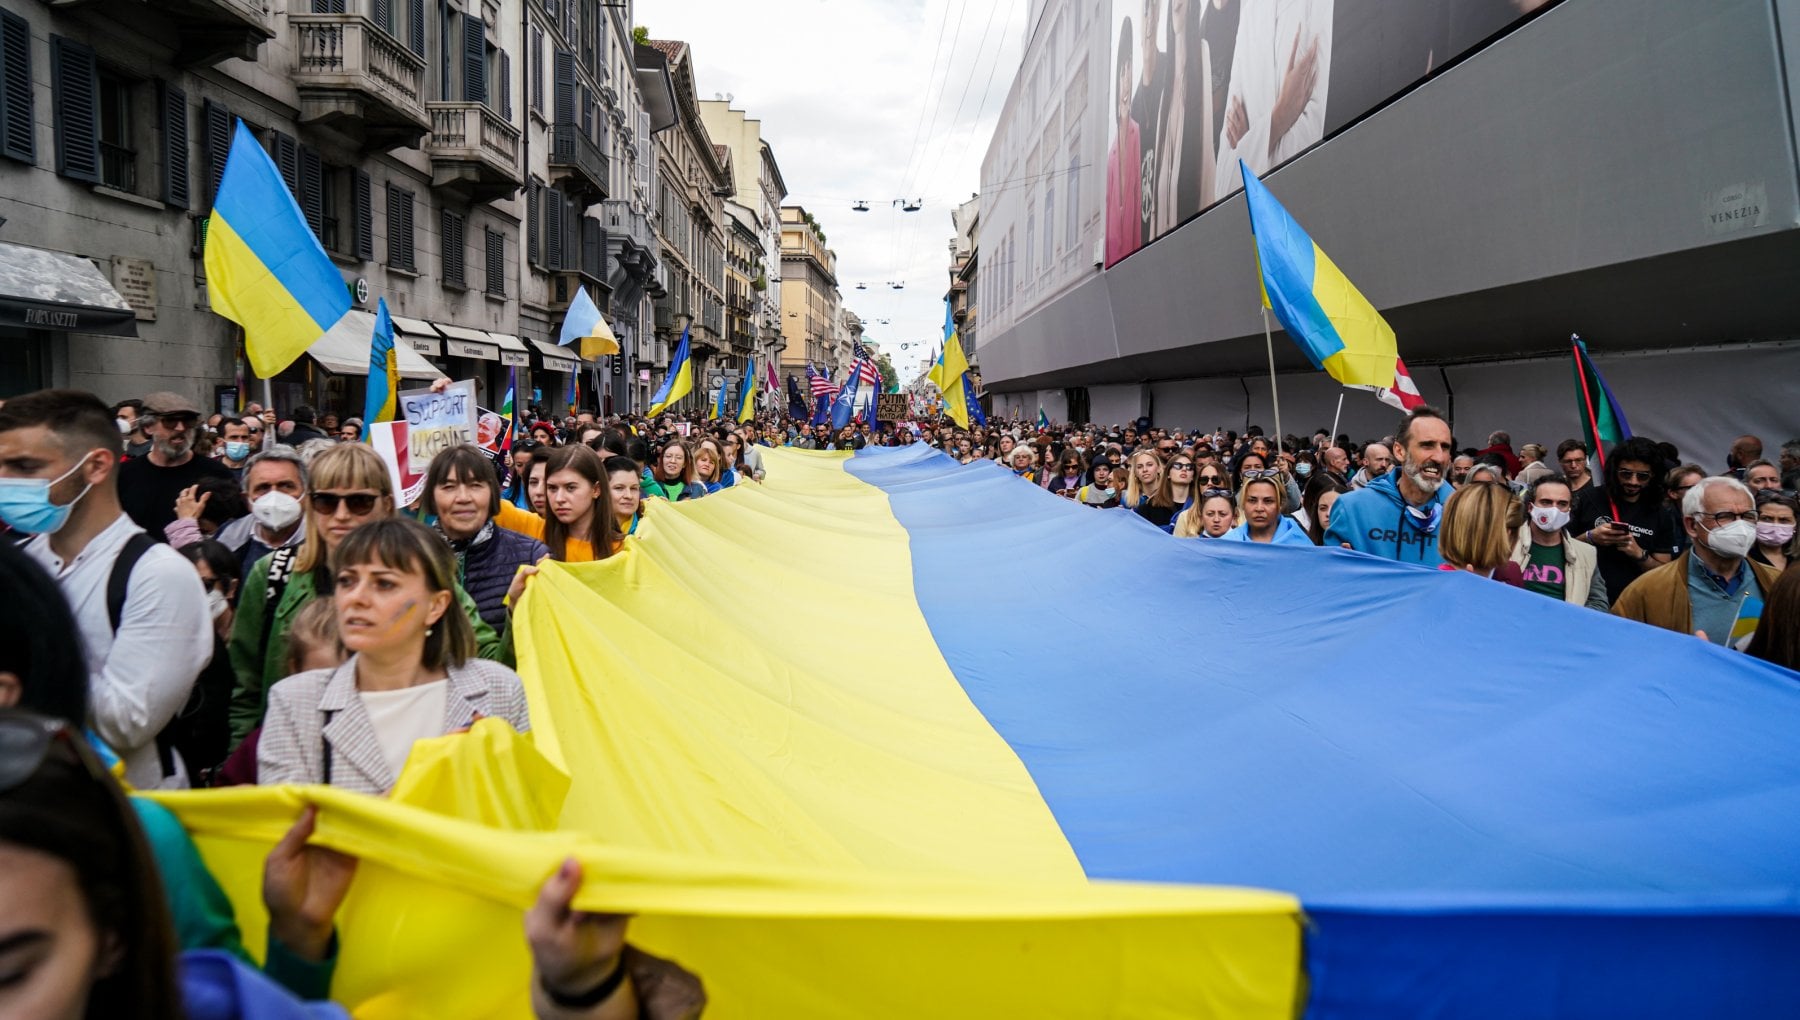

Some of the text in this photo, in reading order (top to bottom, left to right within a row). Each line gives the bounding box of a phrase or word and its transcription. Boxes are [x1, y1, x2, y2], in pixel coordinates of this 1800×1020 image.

[1722, 193, 1743, 203] CORSO
[1710, 205, 1761, 224] VENEZIA
[878, 394, 906, 404] PUTIN
[406, 394, 467, 425] SUPPORT
[1368, 527, 1437, 547] CRAFT
